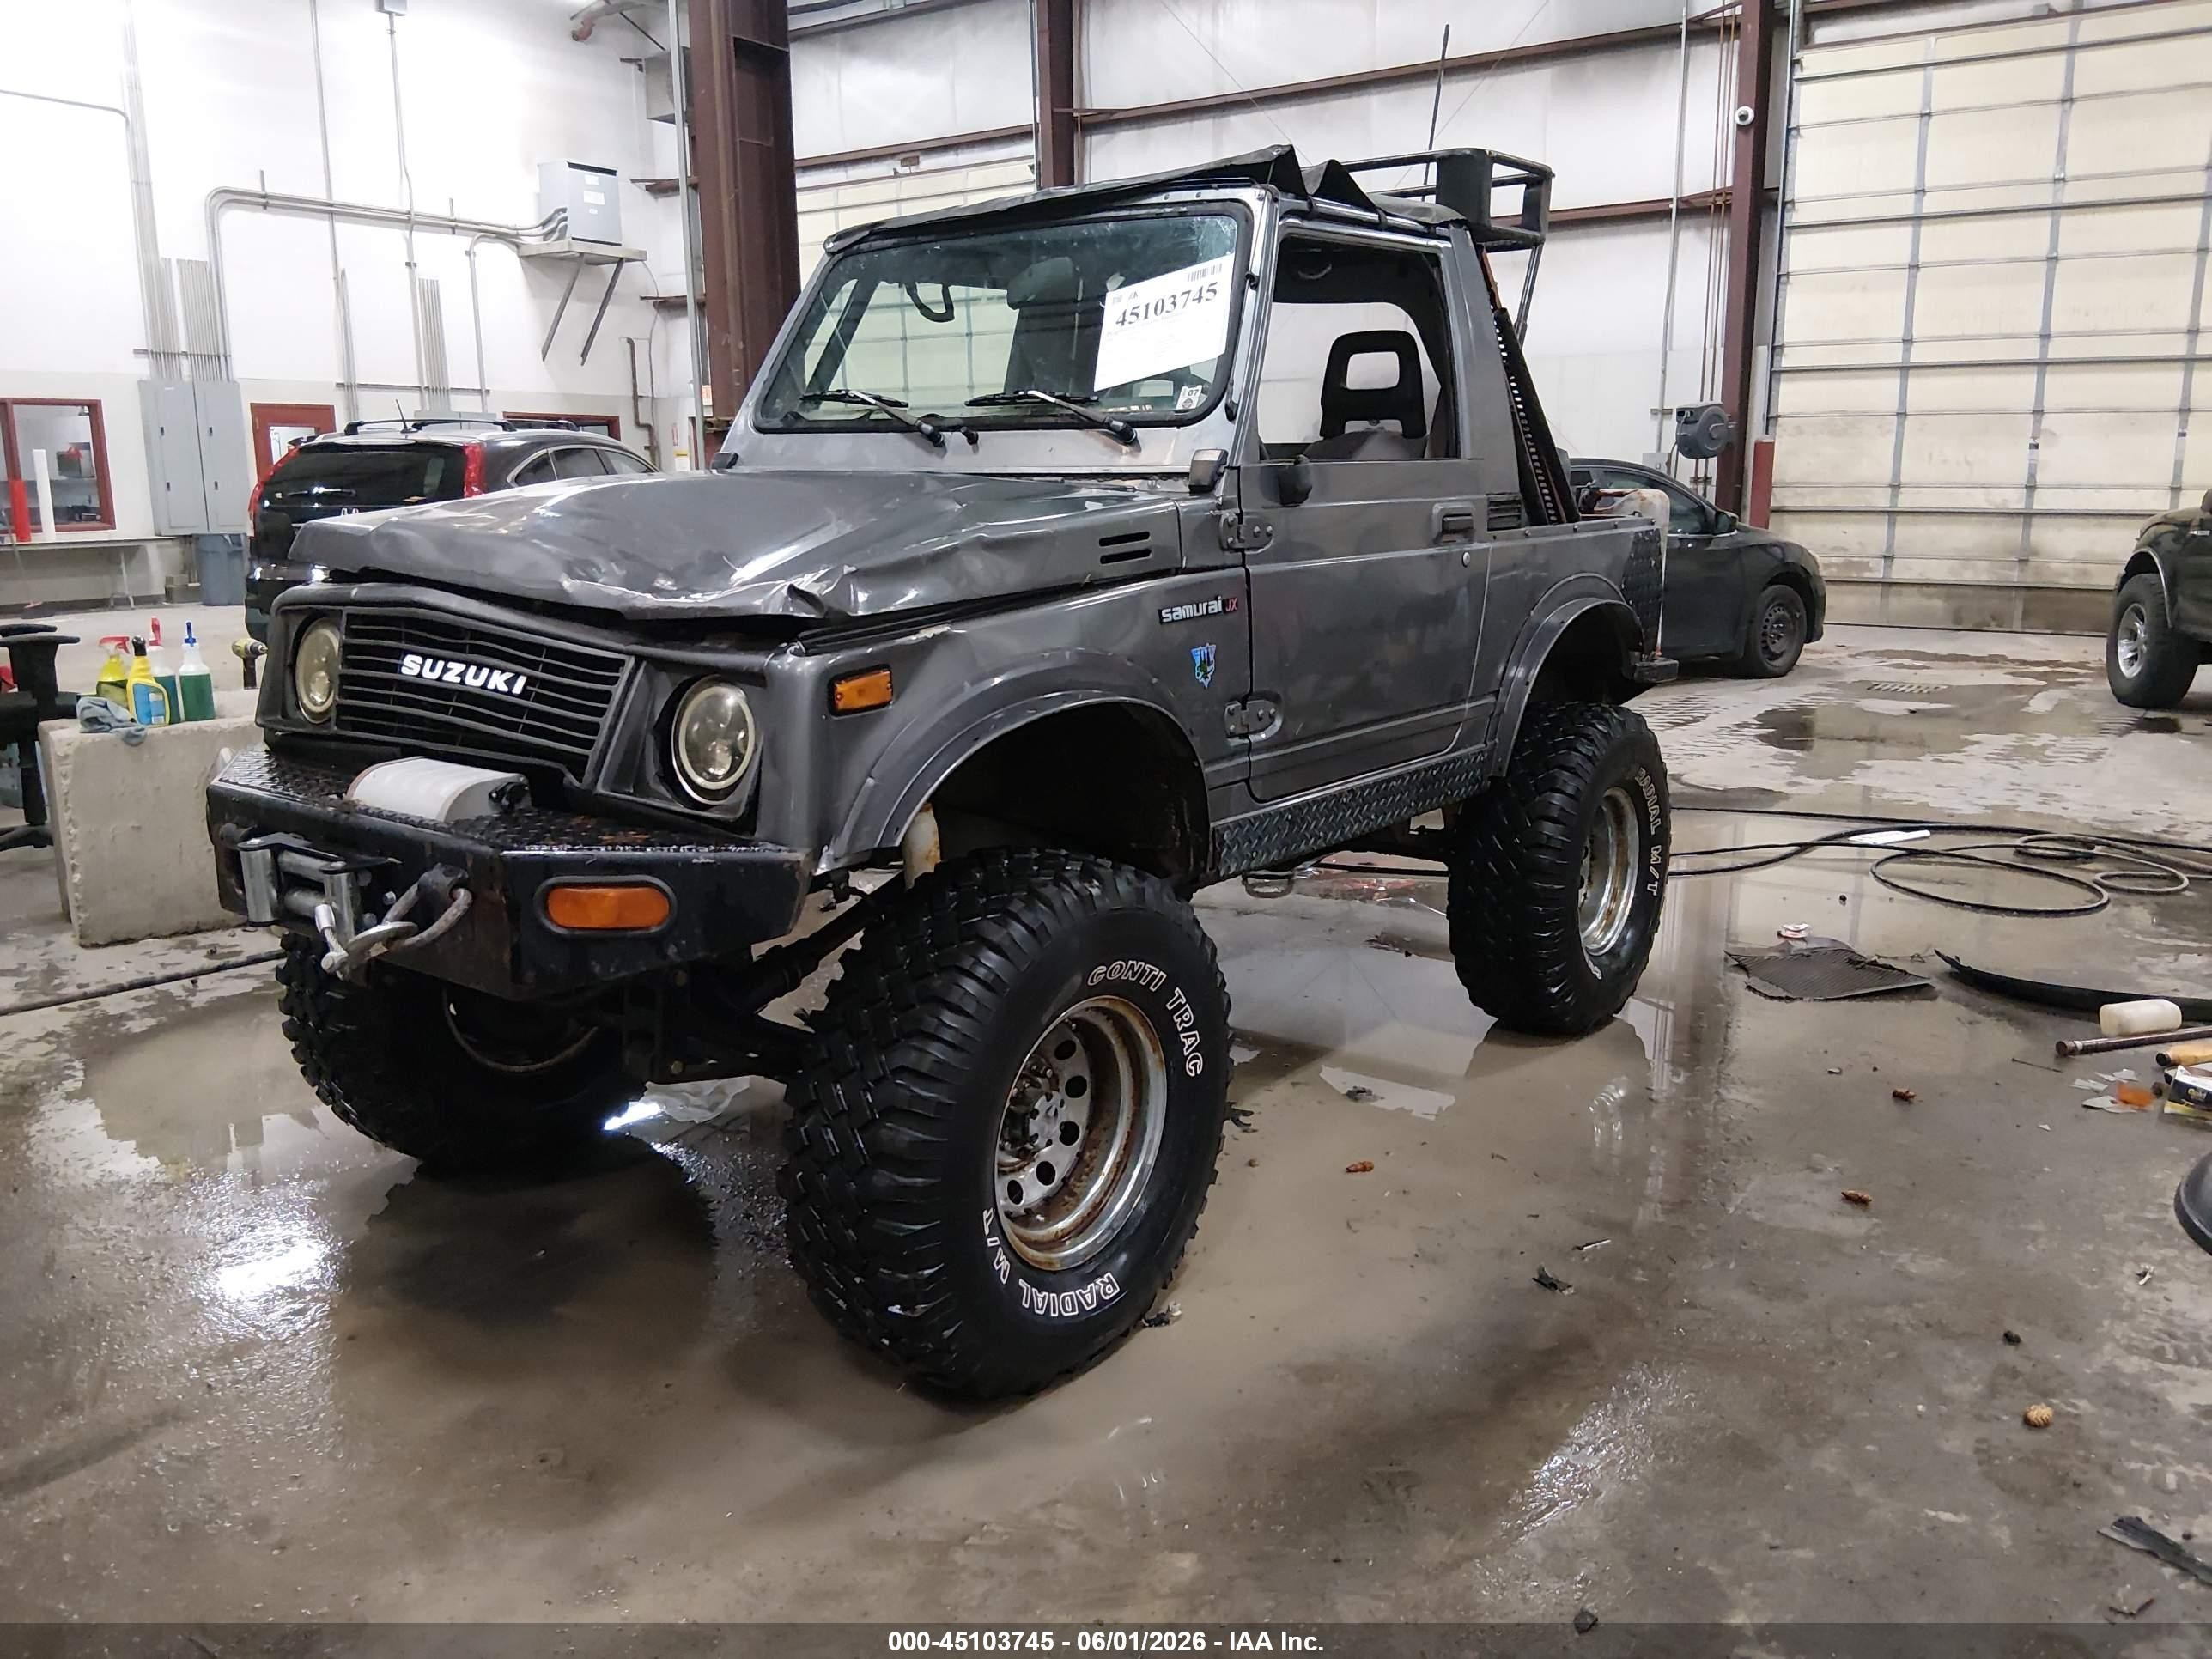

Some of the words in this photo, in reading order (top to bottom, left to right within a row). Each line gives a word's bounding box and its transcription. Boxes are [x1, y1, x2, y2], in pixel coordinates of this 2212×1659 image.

[1115, 282, 1218, 326] 45103745
[1161, 596, 1223, 623] samurai
[1225, 598, 1237, 611] JX
[400, 653, 527, 695] SUZUKI
[1635, 767, 1662, 836] RADIAL
[1646, 844, 1662, 896] M/T
[1087, 960, 1167, 992] CONTI
[1165, 987, 1204, 1077] TRAC
[1018, 1272, 1120, 1317] RADIAL
